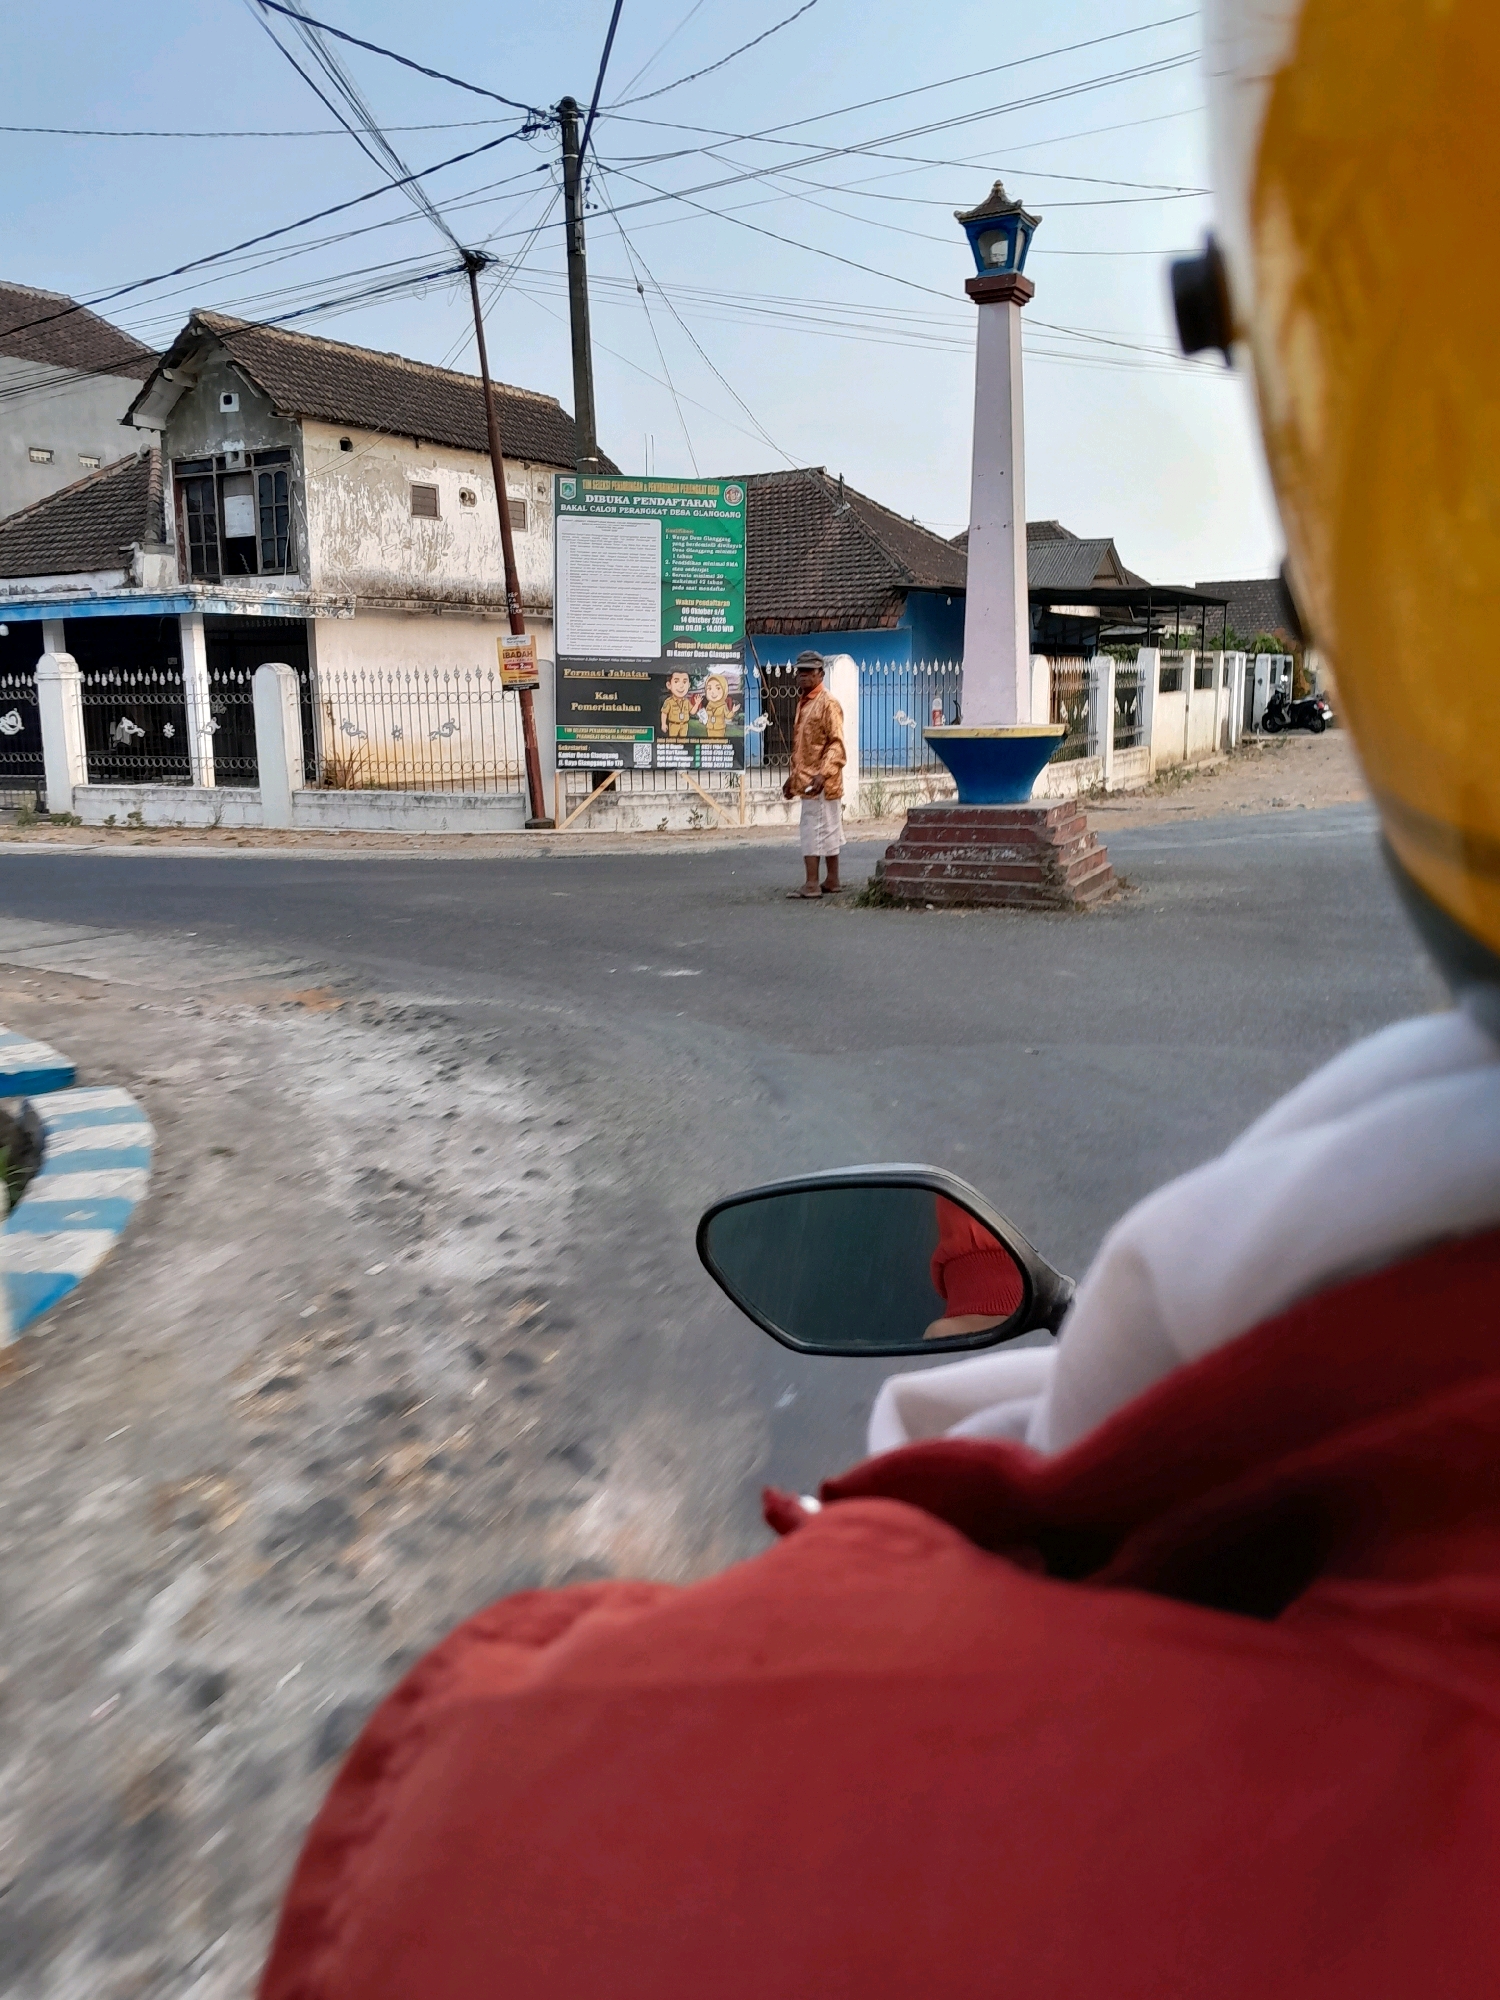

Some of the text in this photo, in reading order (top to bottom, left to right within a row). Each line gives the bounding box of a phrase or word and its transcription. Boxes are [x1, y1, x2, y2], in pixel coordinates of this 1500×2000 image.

[585, 494, 718, 508] DIBUKA PENDAFTARAN
[590, 506, 616, 514] CALON
[619, 506, 668, 515] PERANGKAT
[670, 508, 690, 516] DESA
[693, 510, 742, 518] GLANGGANG
[503, 650, 533, 659] IBADAH
[564, 668, 649, 678] Formasi Jabatan
[594, 692, 618, 700] Kasi
[571, 702, 642, 712] Pemerintahan
